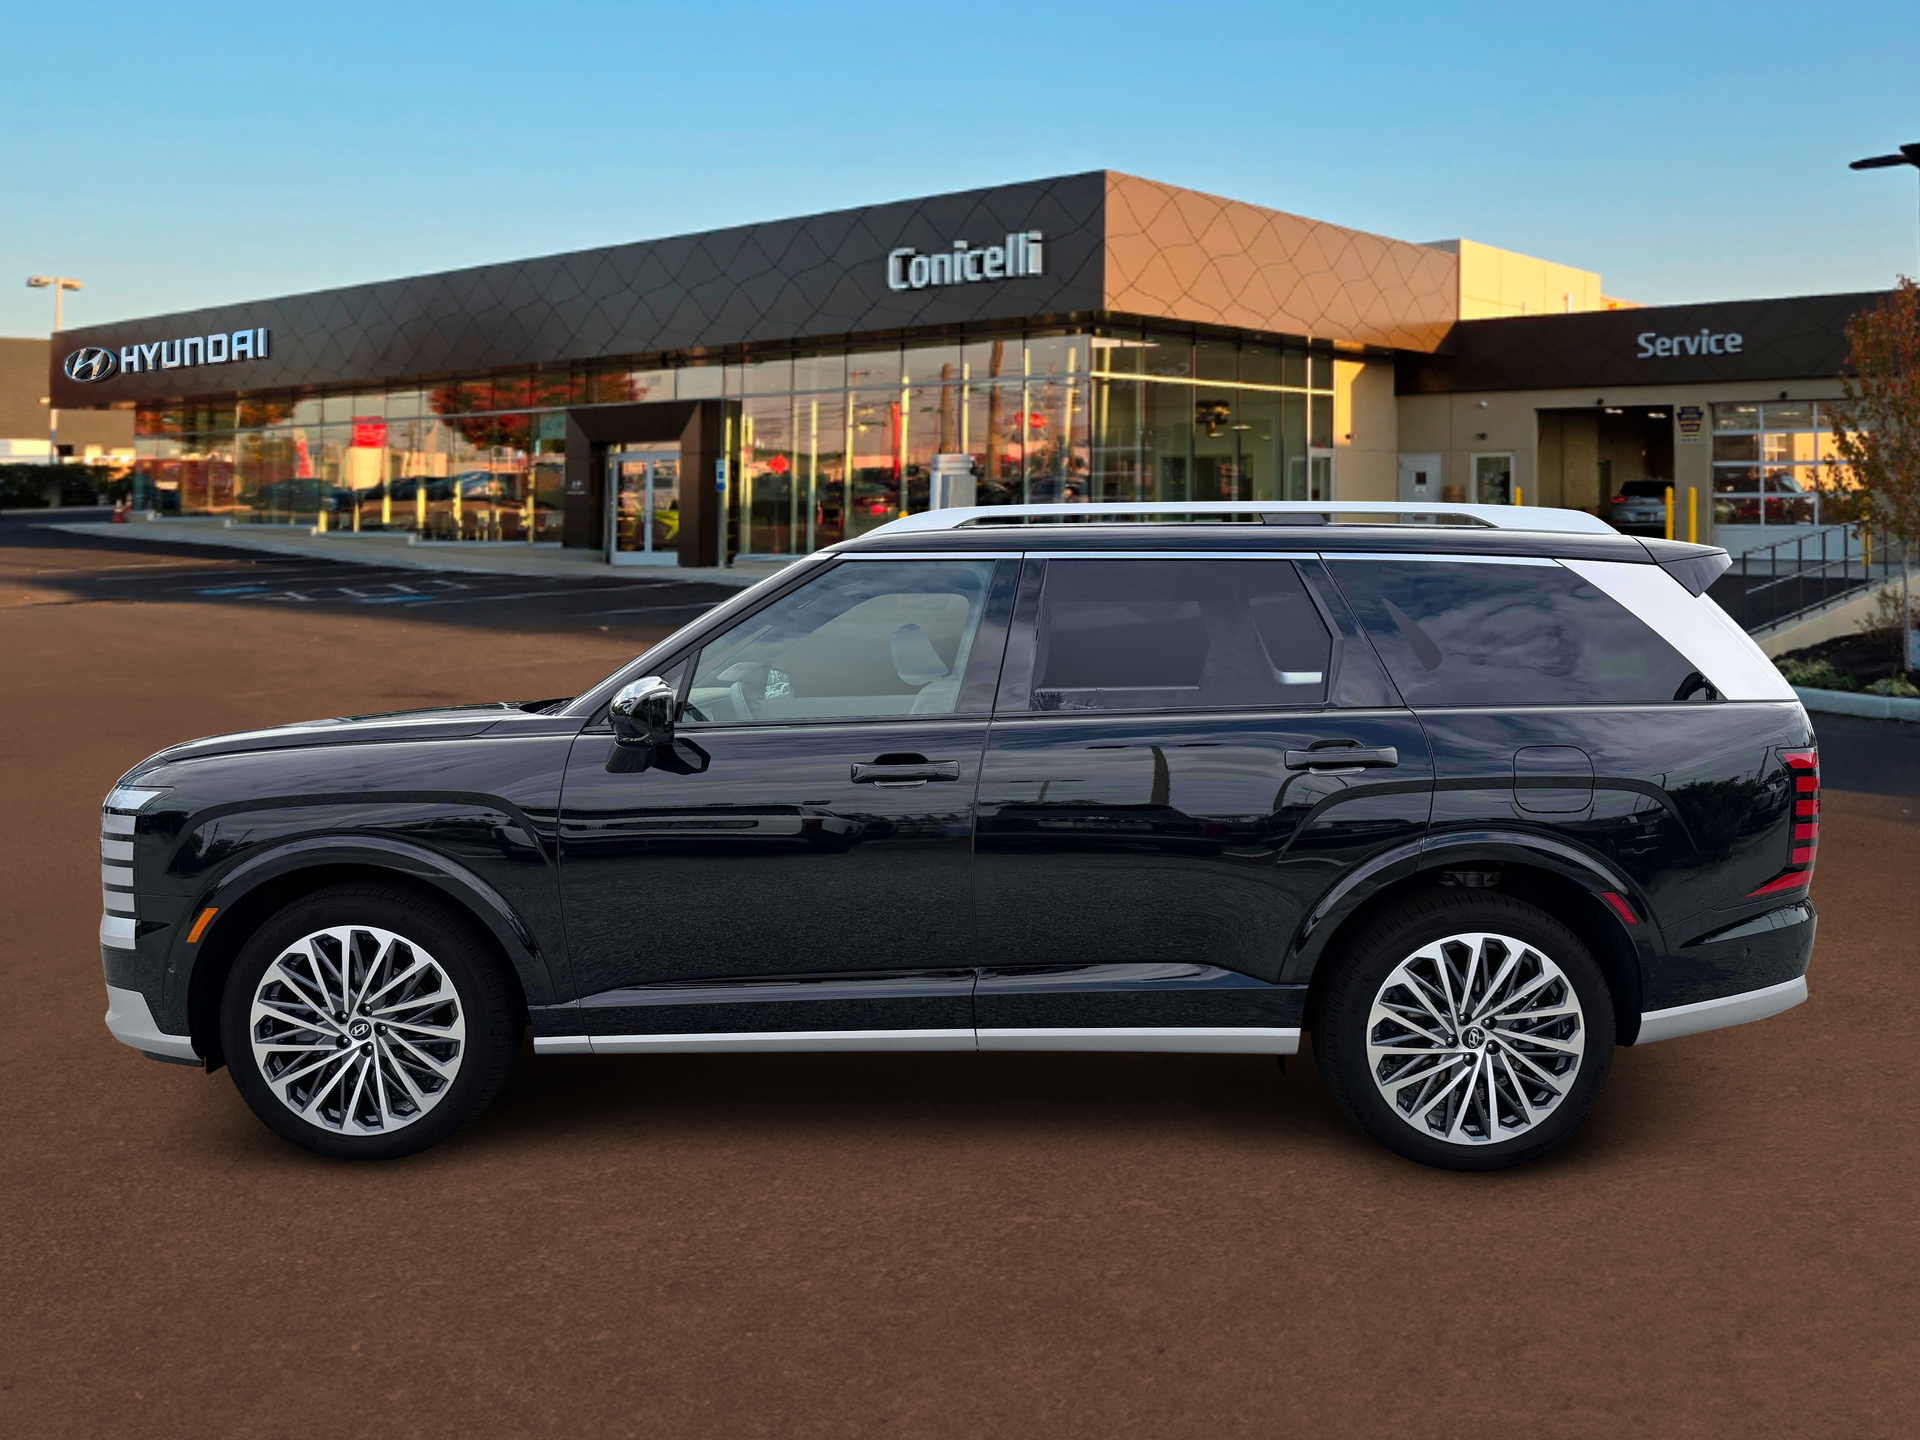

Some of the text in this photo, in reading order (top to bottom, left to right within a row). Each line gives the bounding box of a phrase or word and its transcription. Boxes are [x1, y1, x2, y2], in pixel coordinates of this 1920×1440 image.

[888, 230, 1043, 292] Conicelli
[120, 327, 270, 374] HYUNDAI
[1637, 328, 1743, 359] Service
[398, 914, 441, 945] PIRELLI
